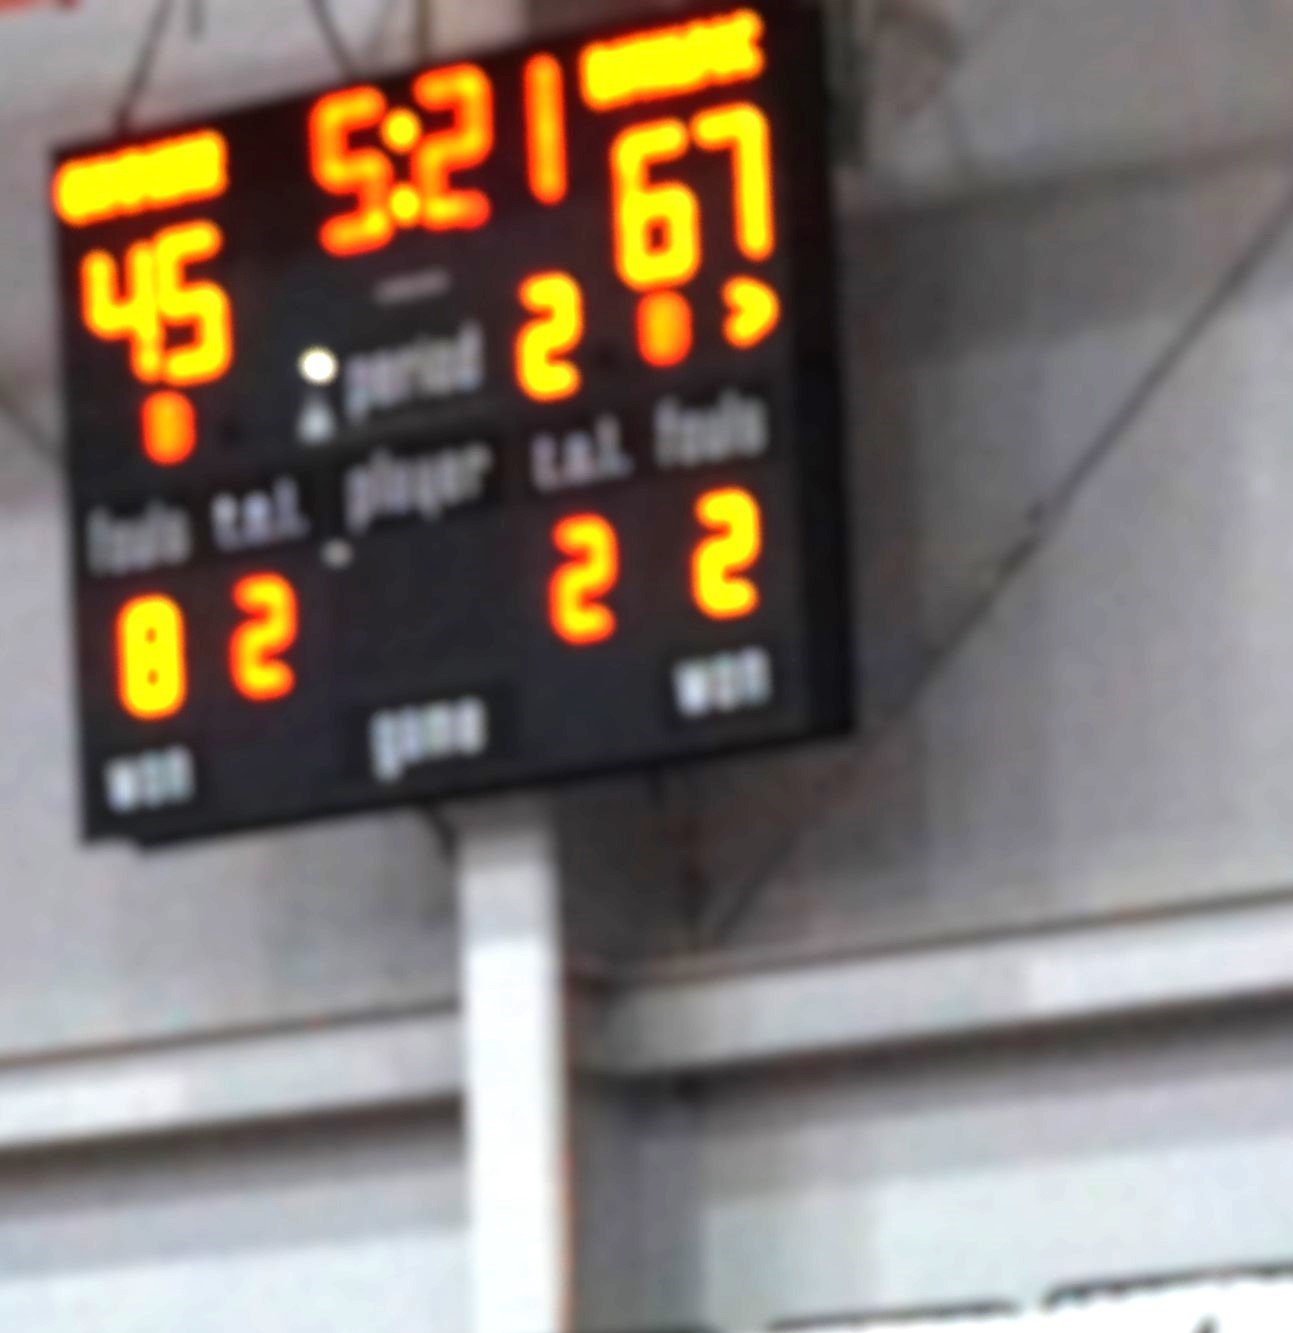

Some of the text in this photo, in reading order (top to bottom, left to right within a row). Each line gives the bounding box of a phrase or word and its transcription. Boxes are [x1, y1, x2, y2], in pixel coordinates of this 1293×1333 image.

[308, 53, 570, 258] 5:21
[610, 102, 776, 291] 67
[80, 220, 234, 386] 45
[514, 271, 585, 402] 2
[547, 511, 620, 646] 2
[688, 485, 762, 622] 2
[228, 570, 298, 701] 2
